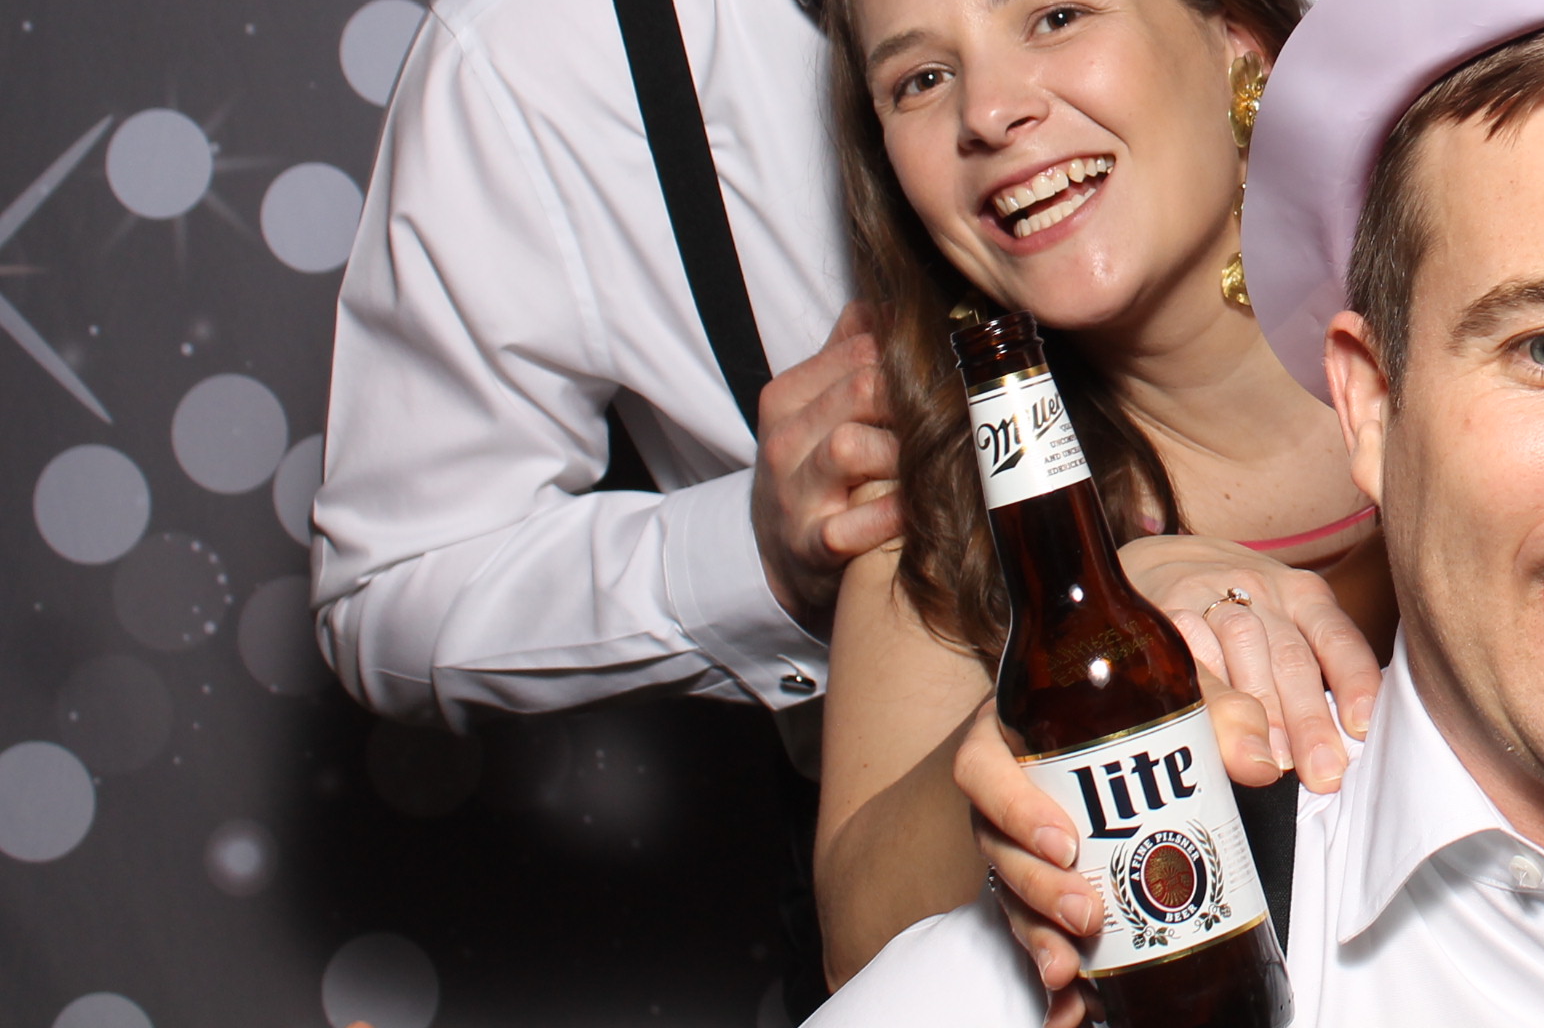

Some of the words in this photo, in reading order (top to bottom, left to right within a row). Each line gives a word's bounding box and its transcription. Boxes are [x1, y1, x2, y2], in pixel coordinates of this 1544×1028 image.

[976, 393, 1060, 466] Mller
[1068, 746, 1198, 839] Lite
[1131, 839, 1153, 868] FINE
[1155, 832, 1199, 861] PILSNER
[1130, 872, 1140, 881] A
[1164, 903, 1198, 923] BEER
